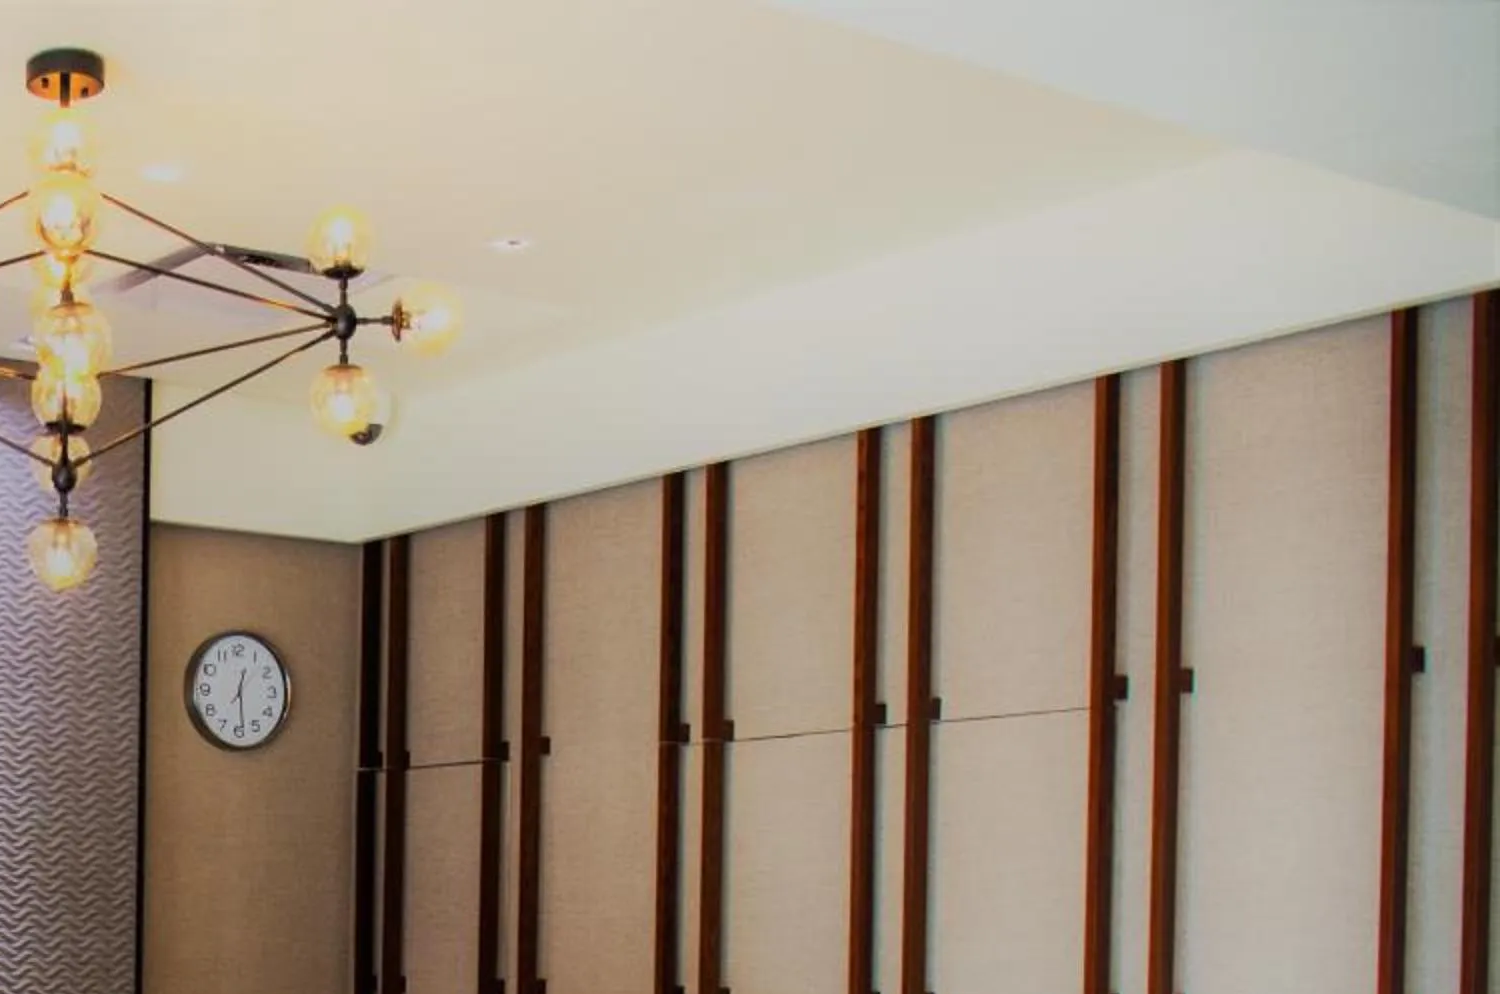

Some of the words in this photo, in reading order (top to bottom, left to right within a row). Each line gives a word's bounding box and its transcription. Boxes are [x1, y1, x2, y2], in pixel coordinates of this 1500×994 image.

[217, 649, 227, 663] 11
[231, 643, 245, 656] 12
[262, 666, 272, 679] 2
[200, 683, 211, 696] 9
[267, 685, 277, 699] 3
[205, 703, 216, 717] 8
[262, 706, 273, 718] 4
[218, 719, 227, 732] 7
[233, 725, 245, 738] 6
[251, 719, 260, 732] 5
